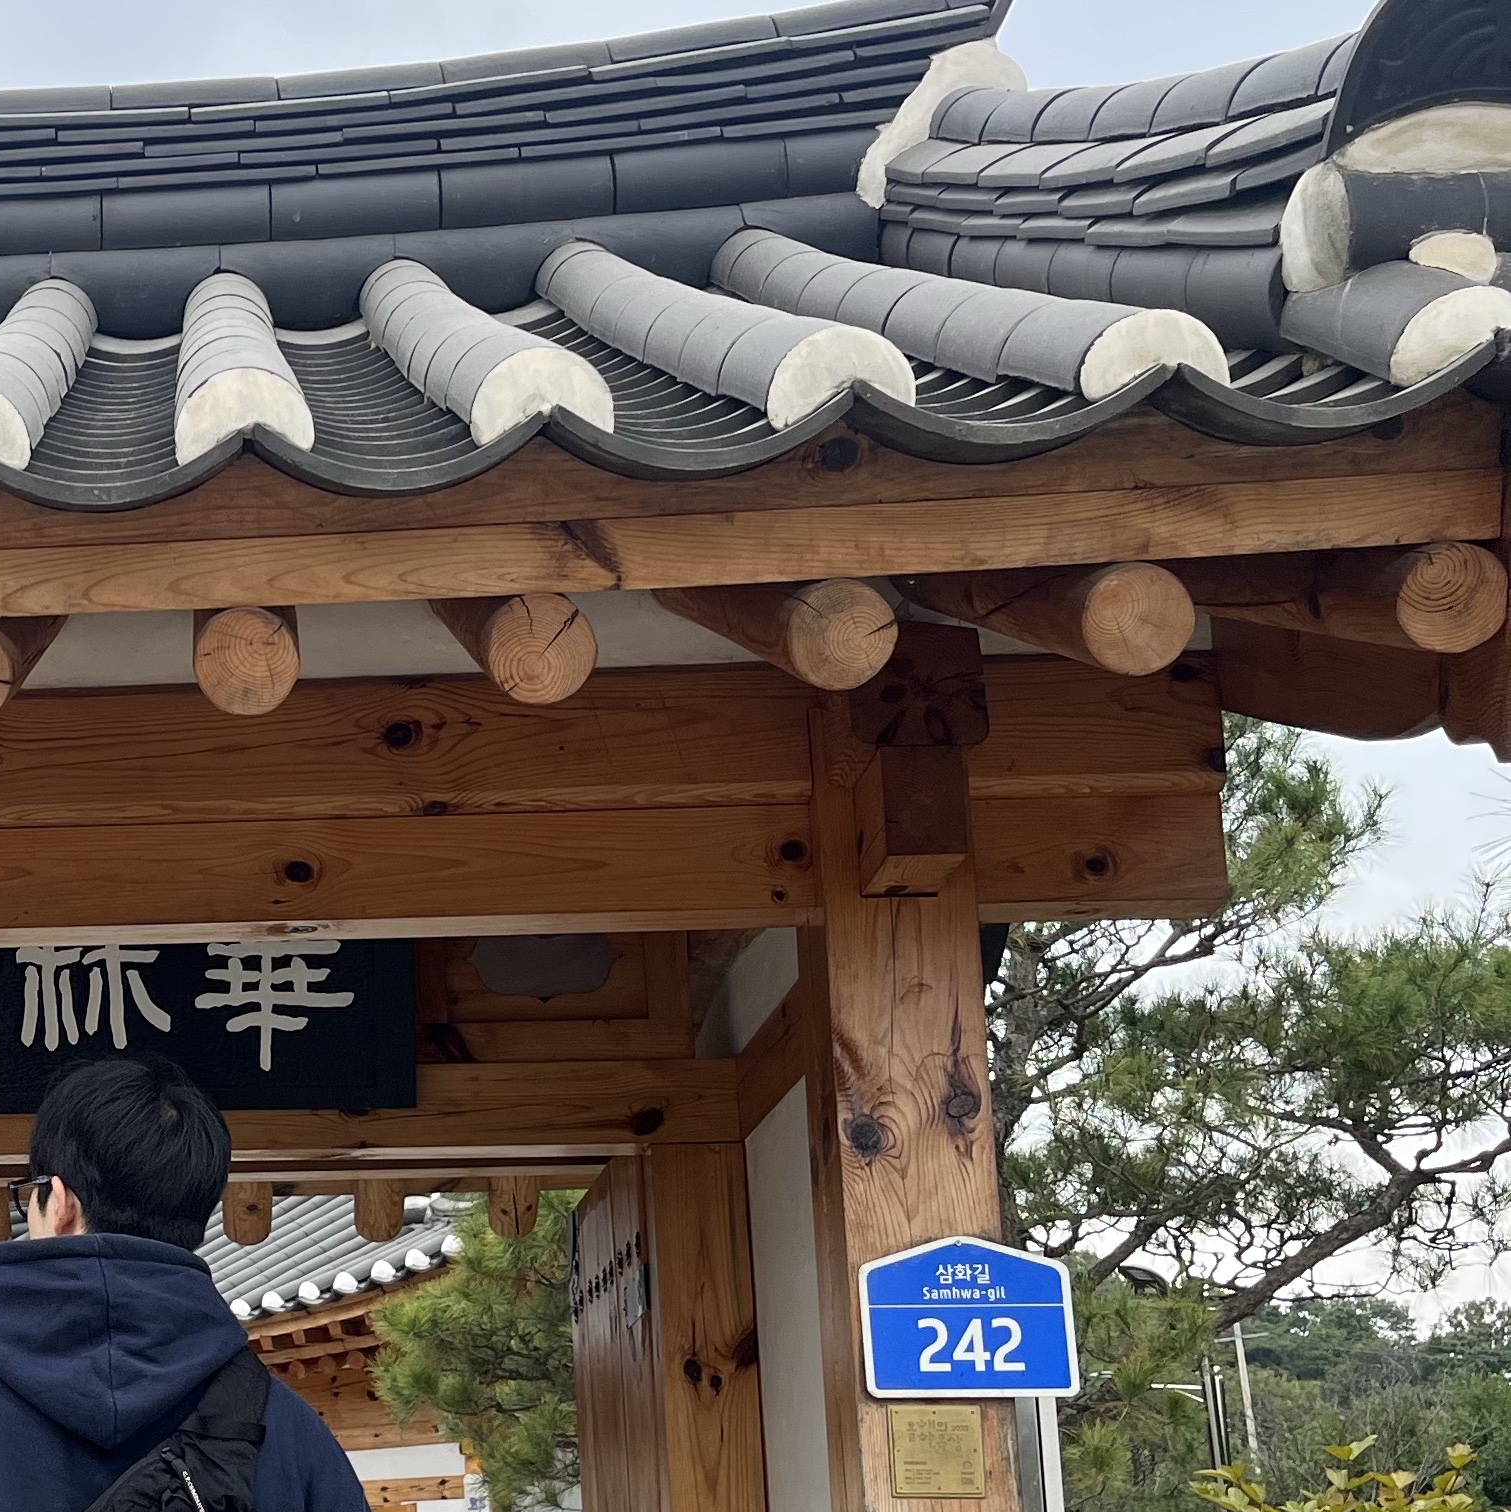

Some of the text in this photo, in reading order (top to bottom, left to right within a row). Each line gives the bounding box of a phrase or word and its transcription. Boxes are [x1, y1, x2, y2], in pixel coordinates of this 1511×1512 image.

[934, 1263, 991, 1285] 삼화길
[922, 1286, 1006, 1301] Samhwa-gil
[917, 1317, 1026, 1373] 242
